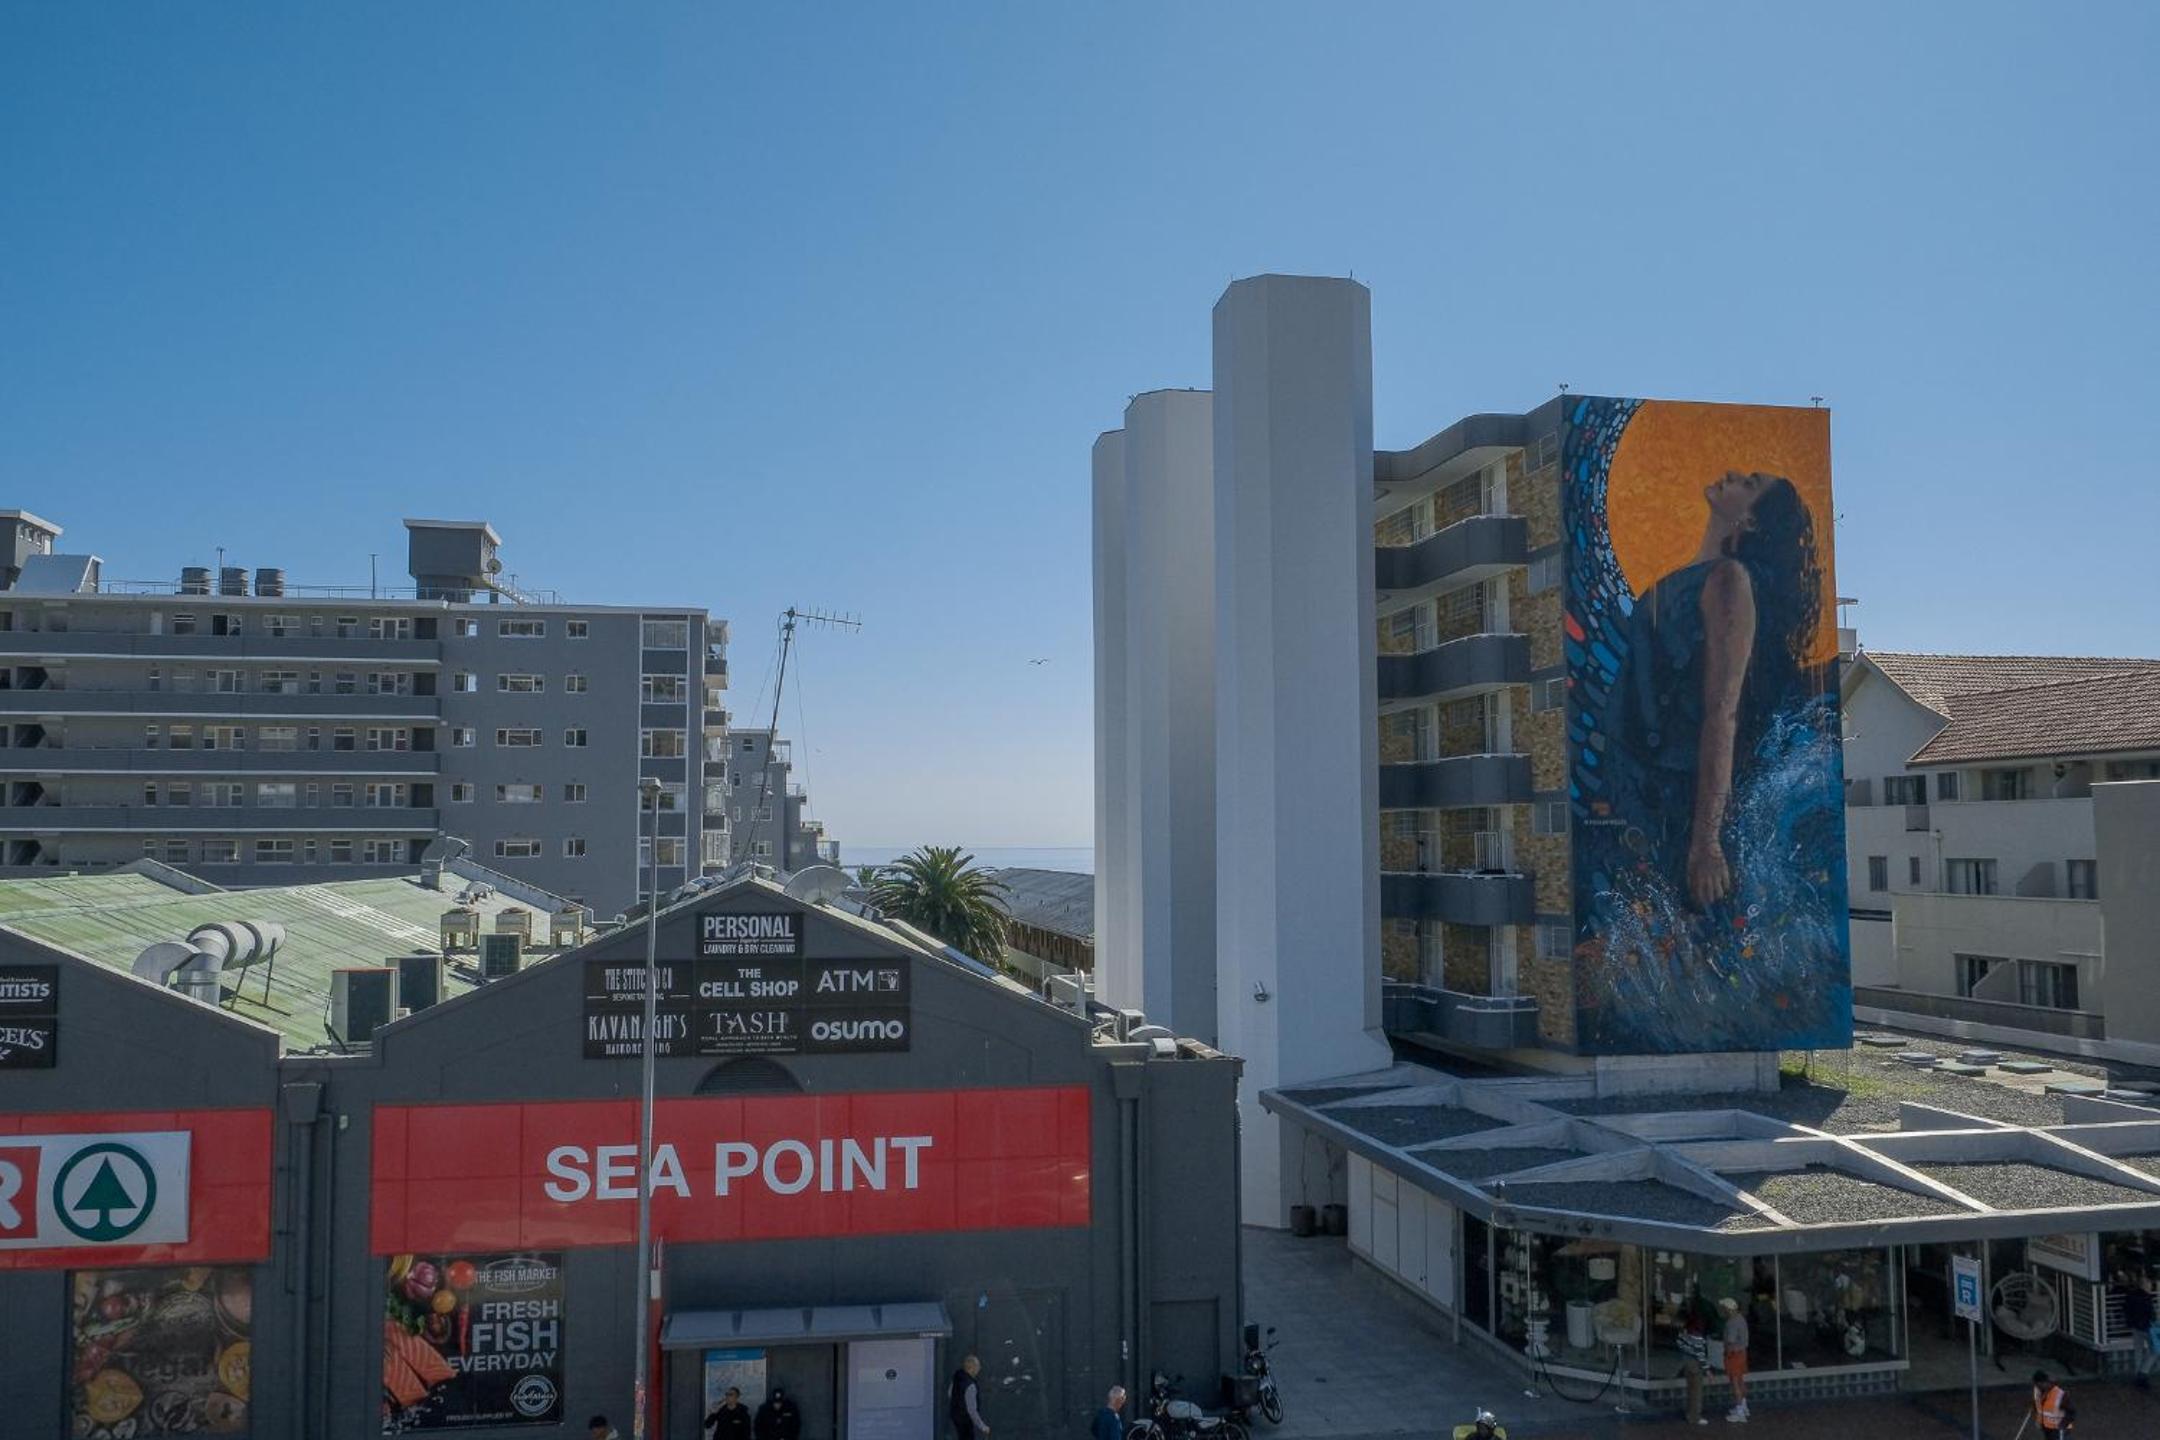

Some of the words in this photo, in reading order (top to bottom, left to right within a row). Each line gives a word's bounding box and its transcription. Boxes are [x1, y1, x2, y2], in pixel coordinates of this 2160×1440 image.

[703, 915, 795, 938] PERSONAL
[737, 968, 761, 979] THE
[816, 970, 874, 993] ATM
[700, 981, 745, 997] CELL
[750, 980, 798, 997] SHOP
[709, 1011, 786, 1034] TASH
[811, 1020, 904, 1040] osumo
[544, 1143, 692, 1202] SEA
[715, 1136, 933, 1197] POINT
[495, 1269, 516, 1281] FISH
[518, 1267, 557, 1280] MARKET
[482, 1300, 558, 1320] FRESH
[472, 1320, 558, 1353] FISH
[448, 1351, 556, 1373] EVERYDAY
